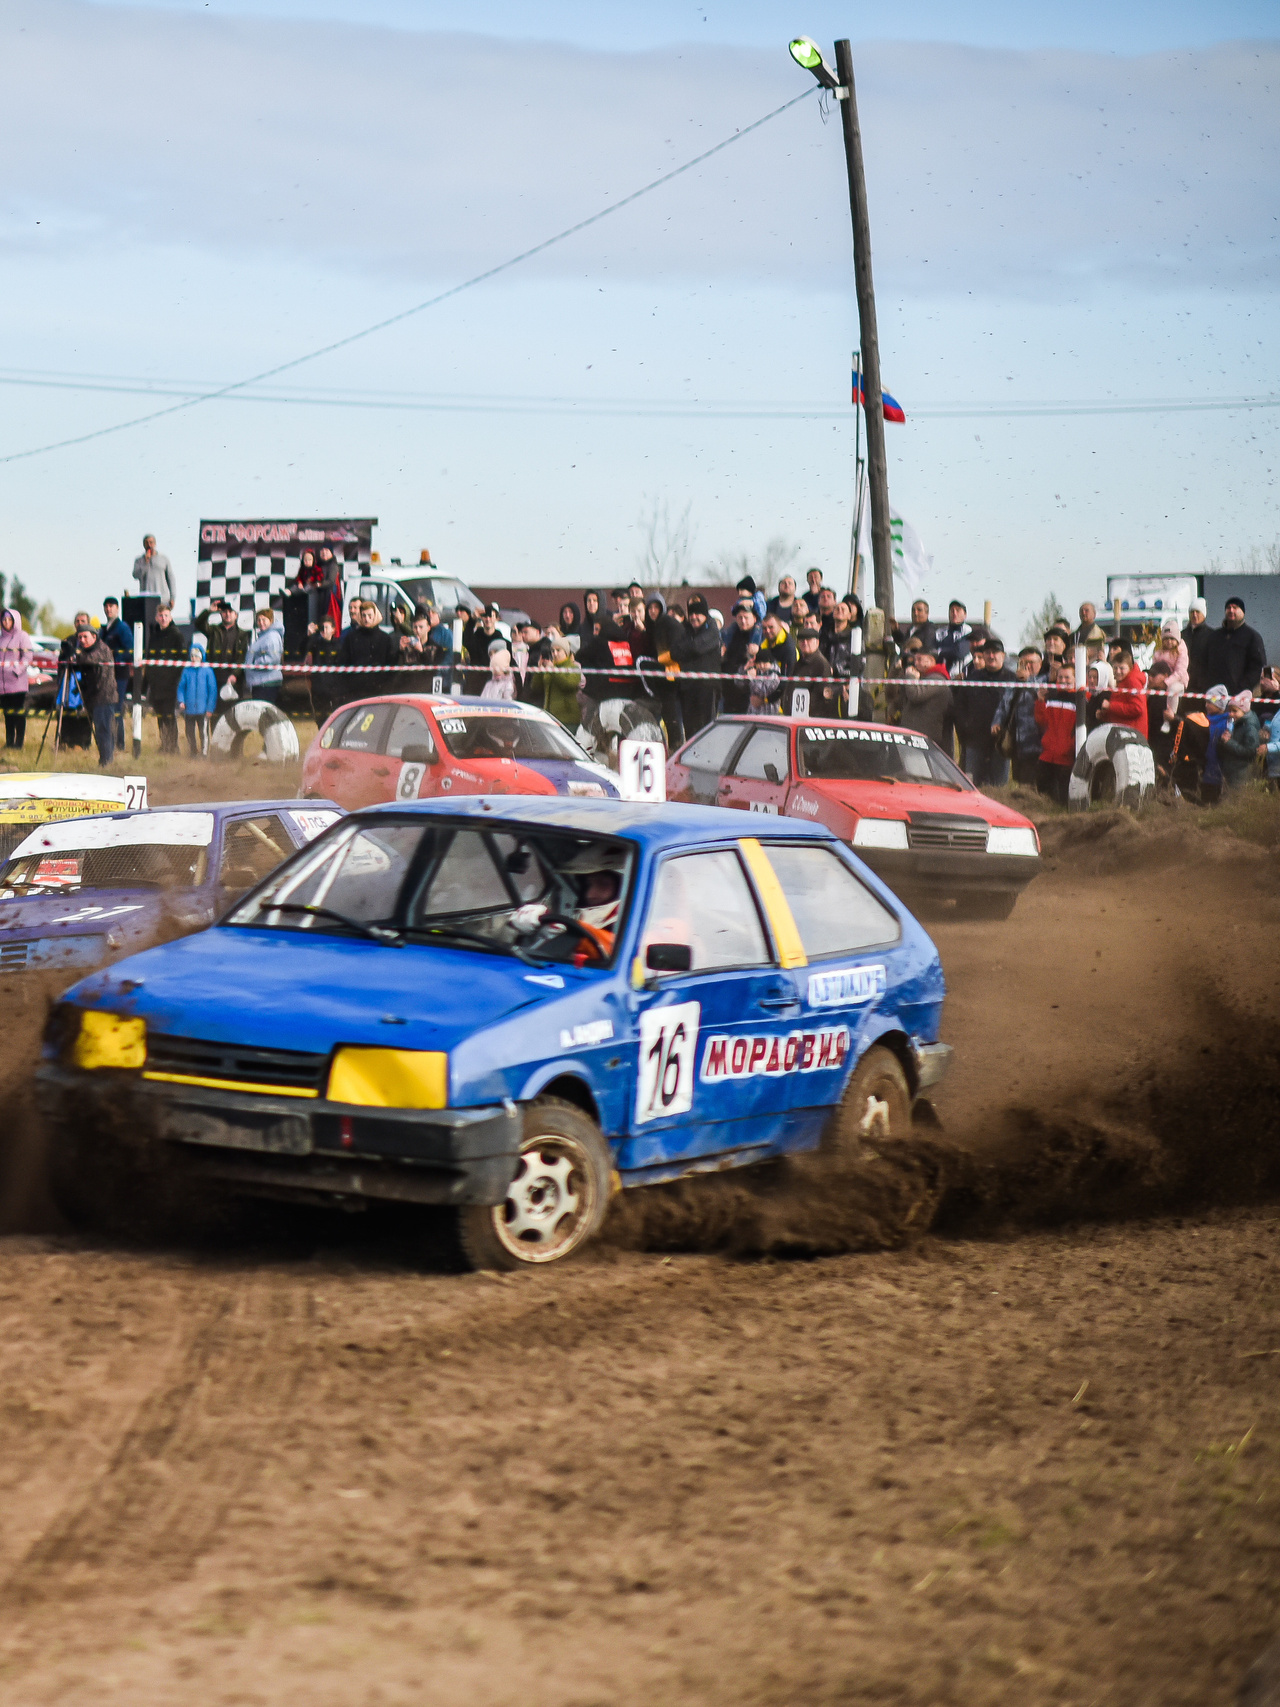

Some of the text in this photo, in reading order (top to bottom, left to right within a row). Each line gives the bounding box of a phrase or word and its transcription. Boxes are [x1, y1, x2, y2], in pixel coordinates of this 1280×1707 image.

[795, 694, 806, 712] 93
[401, 767, 420, 798] 8
[632, 746, 655, 794] 16
[126, 784, 146, 810] 27
[51, 906, 146, 922] 27
[647, 1021, 687, 1111] 16
[707, 1030, 847, 1077] МОРДОВИЯ
